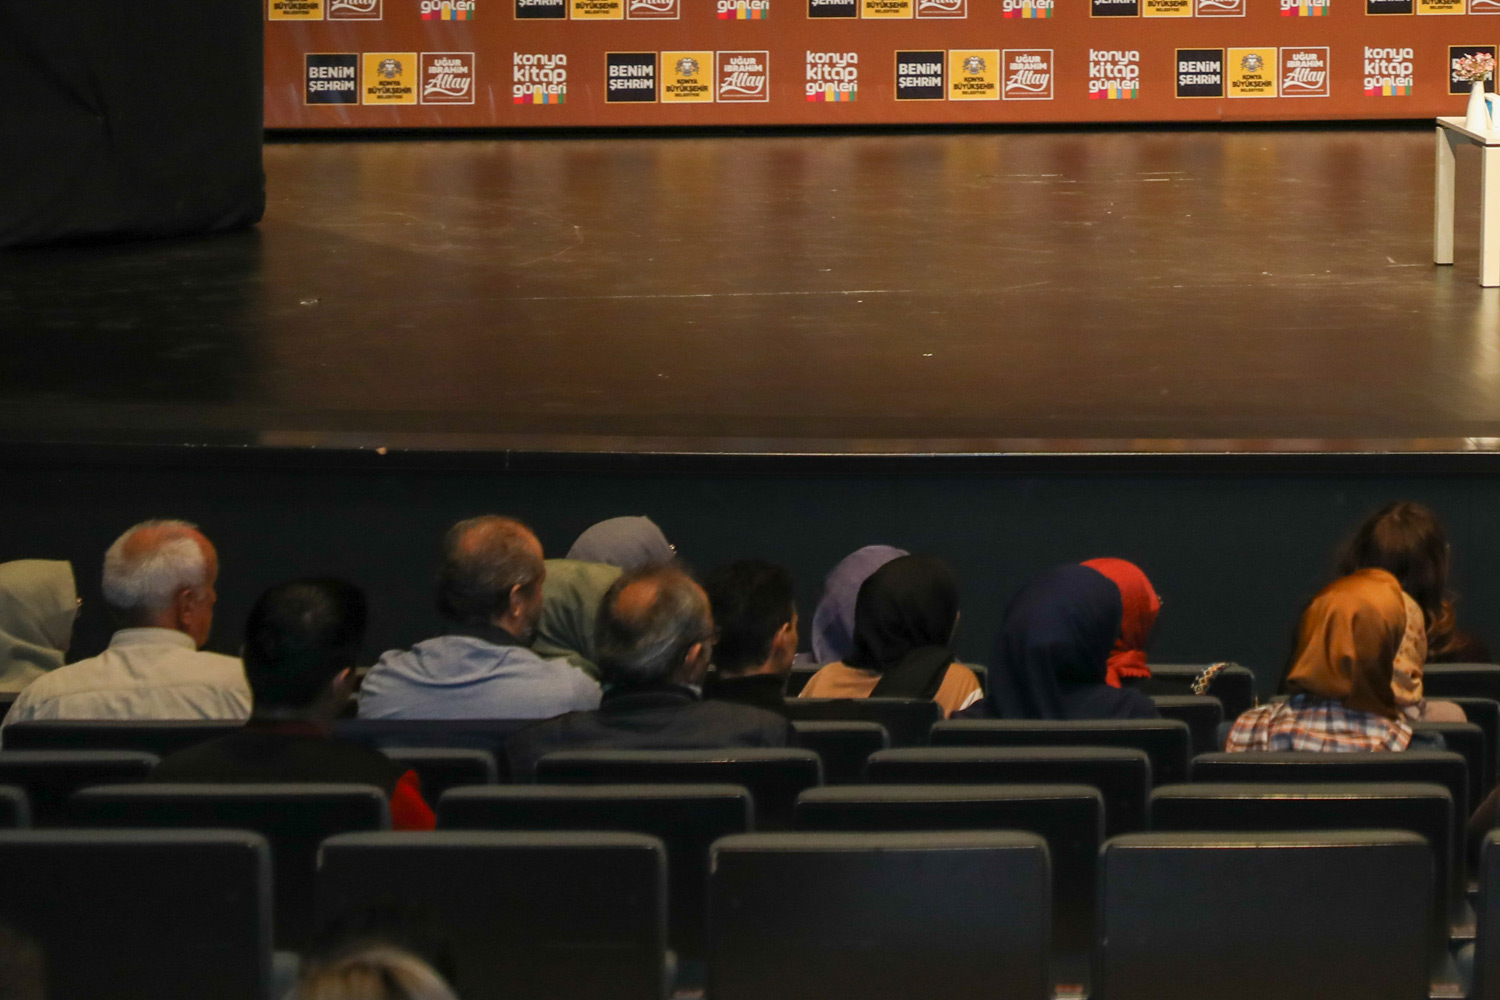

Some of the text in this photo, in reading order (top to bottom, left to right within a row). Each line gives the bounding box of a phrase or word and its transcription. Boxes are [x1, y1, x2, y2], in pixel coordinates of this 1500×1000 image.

[512, 51, 566, 69] konya
[728, 58, 755, 67] UĞUR
[806, 50, 858, 68] konya
[1088, 48, 1140, 66] konya
[1364, 46, 1414, 62] konya
[512, 66, 566, 85] kitap
[806, 65, 858, 83] kitap
[1088, 62, 1140, 80] kitap
[1364, 59, 1414, 78] kitap
[512, 82, 566, 98] günleri
[718, 73, 764, 95] Altay
[806, 81, 858, 96] günleri
[1088, 78, 1140, 93] günleri
[1364, 75, 1414, 90] günleri
